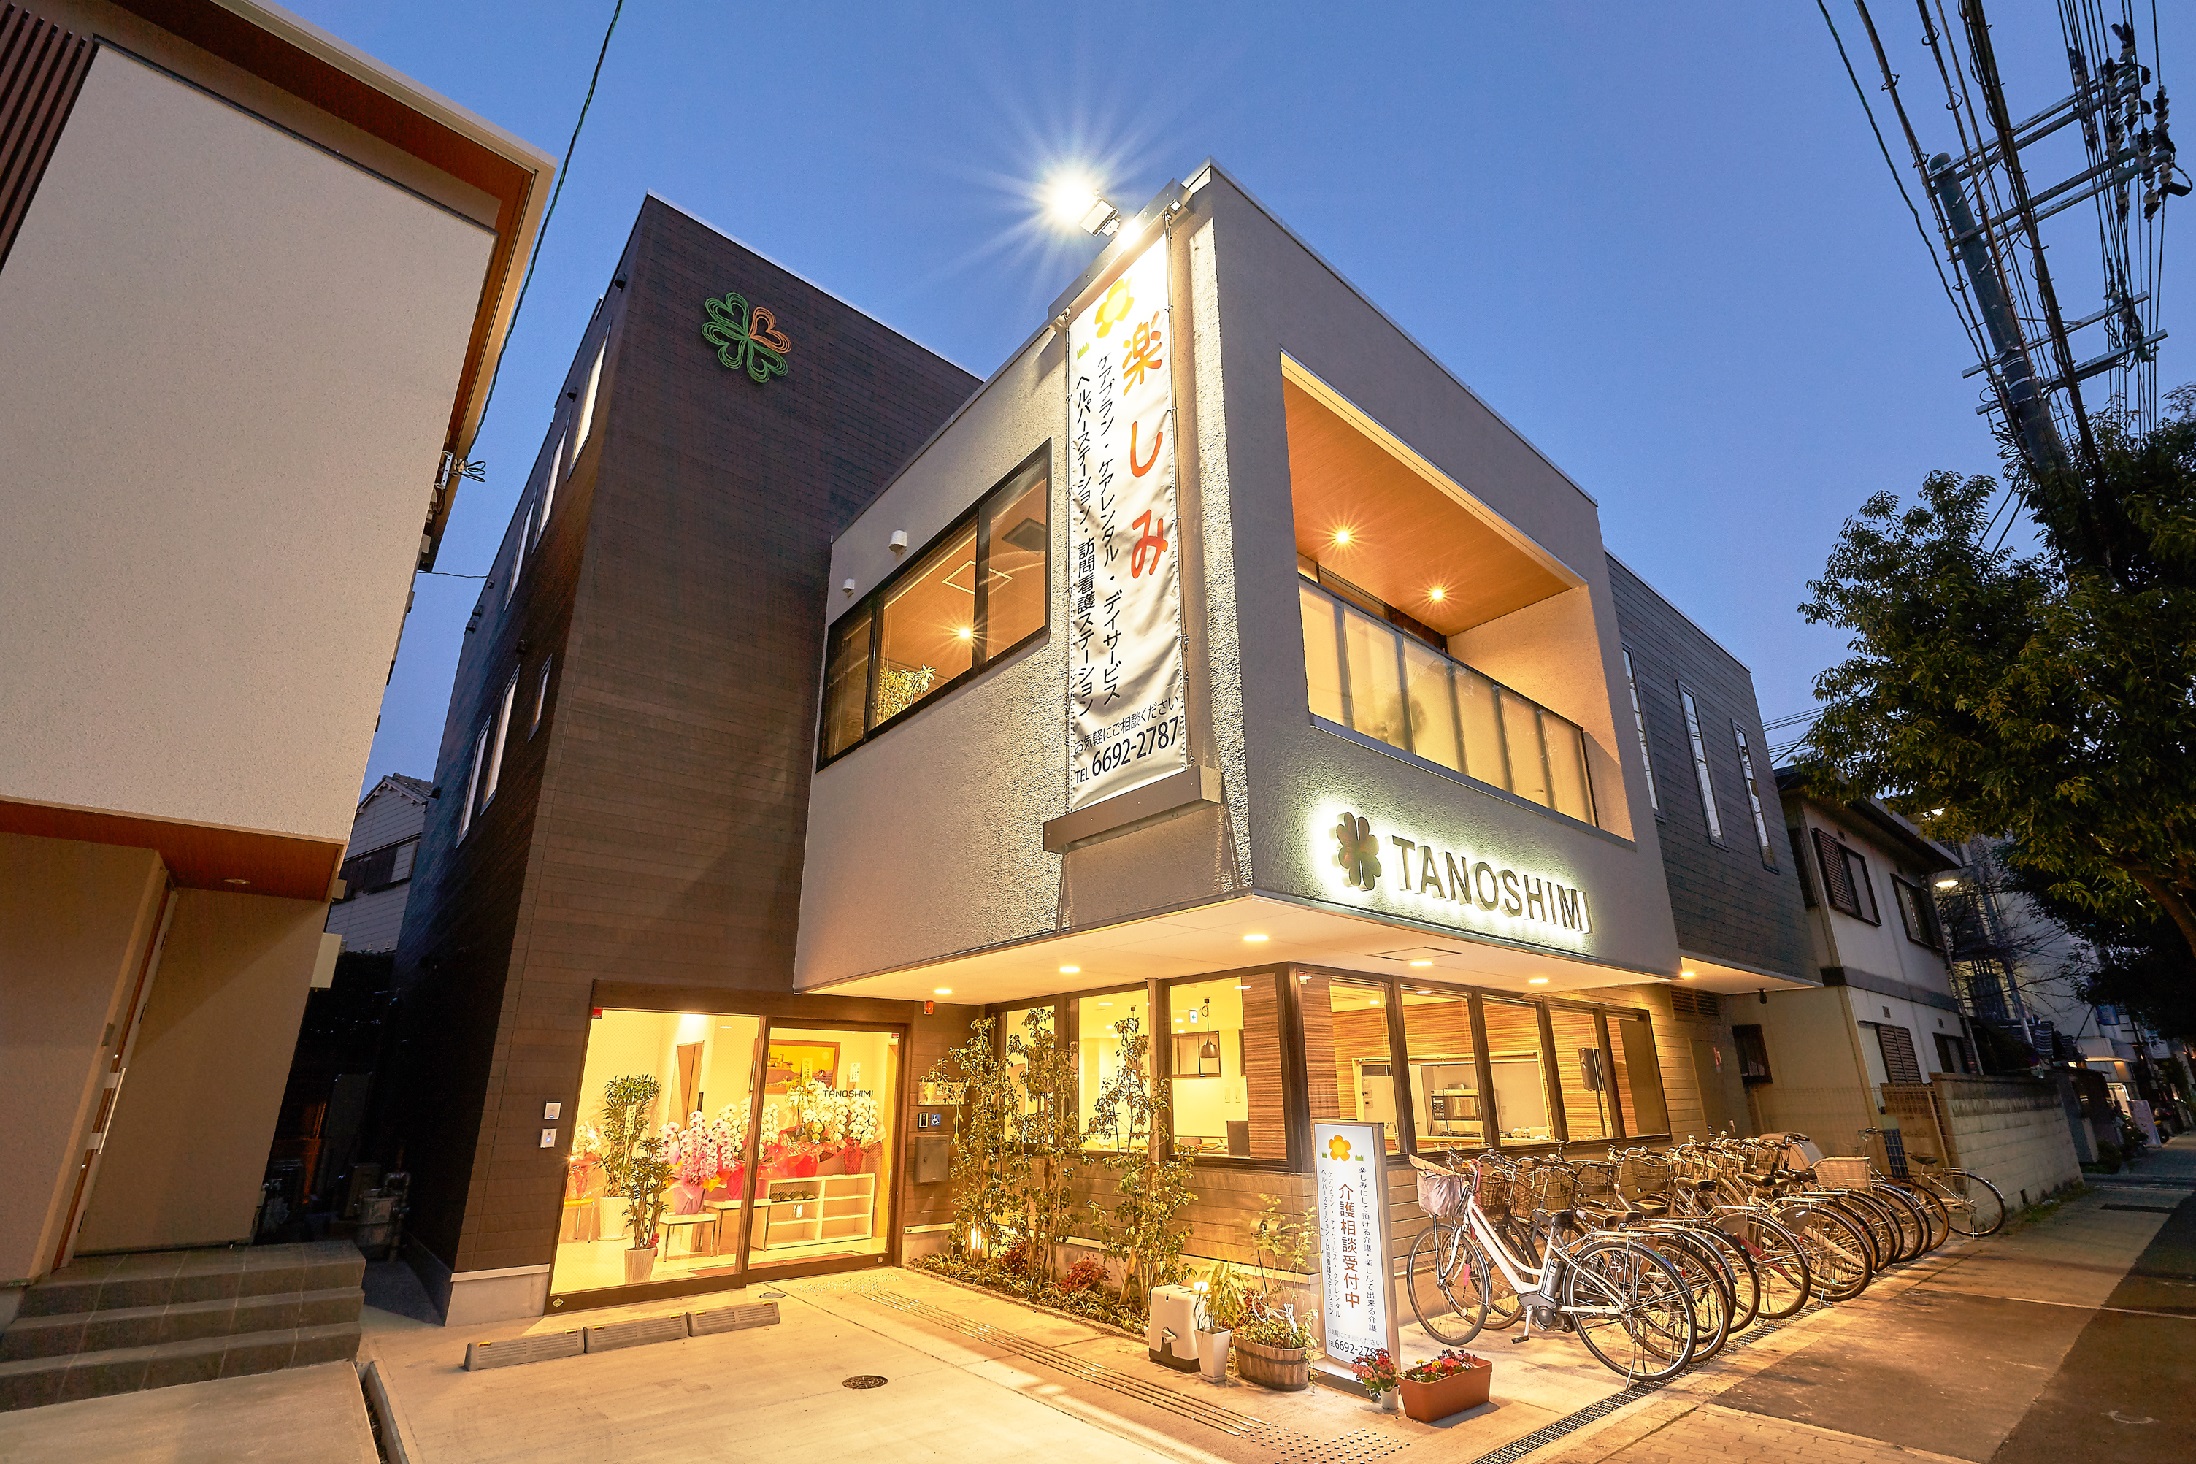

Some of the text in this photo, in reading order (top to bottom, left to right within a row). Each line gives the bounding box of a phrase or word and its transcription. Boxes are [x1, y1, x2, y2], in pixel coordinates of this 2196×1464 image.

[1122, 311, 1168, 578] 楽しみ
[1074, 696, 1179, 754] お気軽にご相談ください
[1075, 716, 1179, 784] TEL 6692-2787
[1389, 834, 1593, 934] TANOSHIMI
[1339, 1183, 1360, 1309] 介護相談受付中
